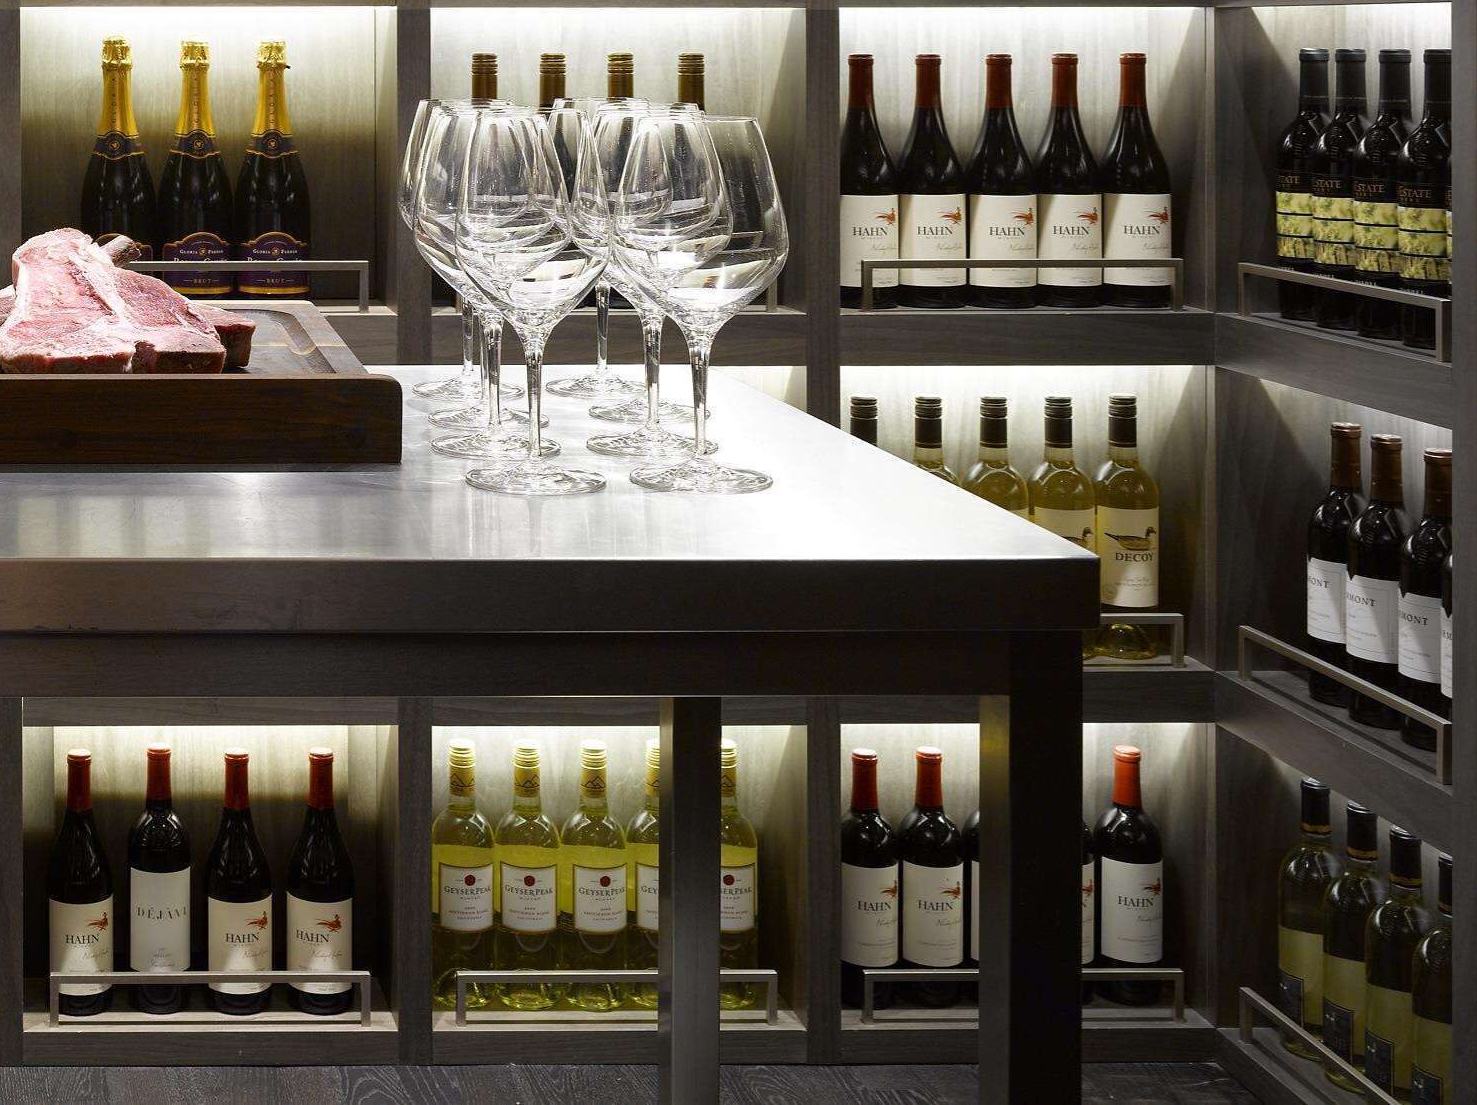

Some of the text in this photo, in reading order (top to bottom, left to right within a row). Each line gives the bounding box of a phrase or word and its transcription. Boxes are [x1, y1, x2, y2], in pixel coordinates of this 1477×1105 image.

[852, 227, 888, 237] HAHN
[917, 226, 954, 236] HAHN
[989, 227, 1026, 237] HAHN
[1053, 226, 1090, 236] HAHN
[1124, 225, 1161, 236] HAHN
[1115, 552, 1154, 563] DECOY
[857, 901, 892, 912] HAHN
[917, 899, 954, 912] HAHN
[1118, 895, 1154, 908] HAHN
[65, 933, 100, 944] HAHN
[226, 932, 260, 943] HAHN
[296, 930, 330, 943] HAHN
